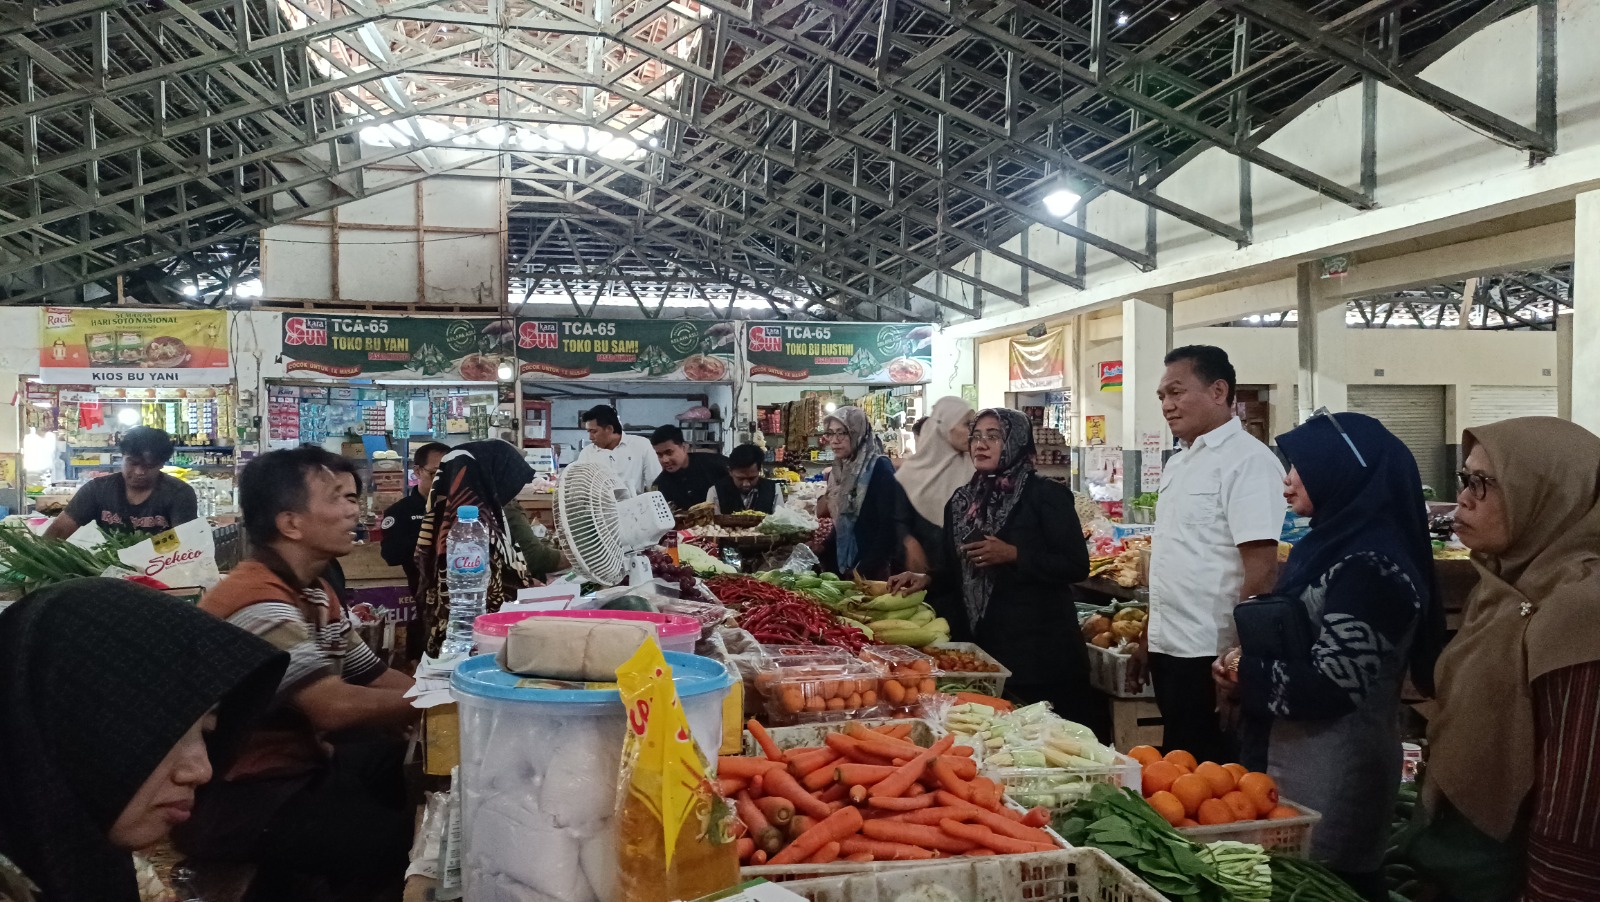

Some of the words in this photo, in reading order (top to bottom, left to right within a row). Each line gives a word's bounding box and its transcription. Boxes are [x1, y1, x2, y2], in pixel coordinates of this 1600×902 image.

[47, 314, 74, 325] Racik
[135, 316, 178, 324] NASIONAL
[306, 319, 324, 328] kara
[331, 318, 389, 333] TCA-65
[284, 317, 328, 346] SUN
[518, 321, 559, 349] SUN
[539, 323, 556, 333] kara
[562, 321, 616, 336] TCA-65
[785, 326, 831, 340] TCA-65
[332, 336, 362, 350] TOKO
[365, 337, 382, 351] BU
[384, 338, 409, 352] YANI
[748, 325, 783, 352] SUN
[563, 339, 592, 352] TOKO
[594, 340, 611, 353] BU
[612, 340, 639, 354] SAMI
[785, 343, 807, 356] TOKO
[808, 343, 820, 356] BU
[821, 343, 854, 356] RUSTINI
[288, 362, 308, 370] COCOK
[309, 363, 329, 372] UNTUK
[521, 364, 541, 372] COCOK
[541, 365, 560, 373] UNTUK
[92, 372, 123, 381] KIOS
[127, 372, 144, 381] BU
[149, 372, 180, 381] YANI
[454, 555, 481, 569] Club
